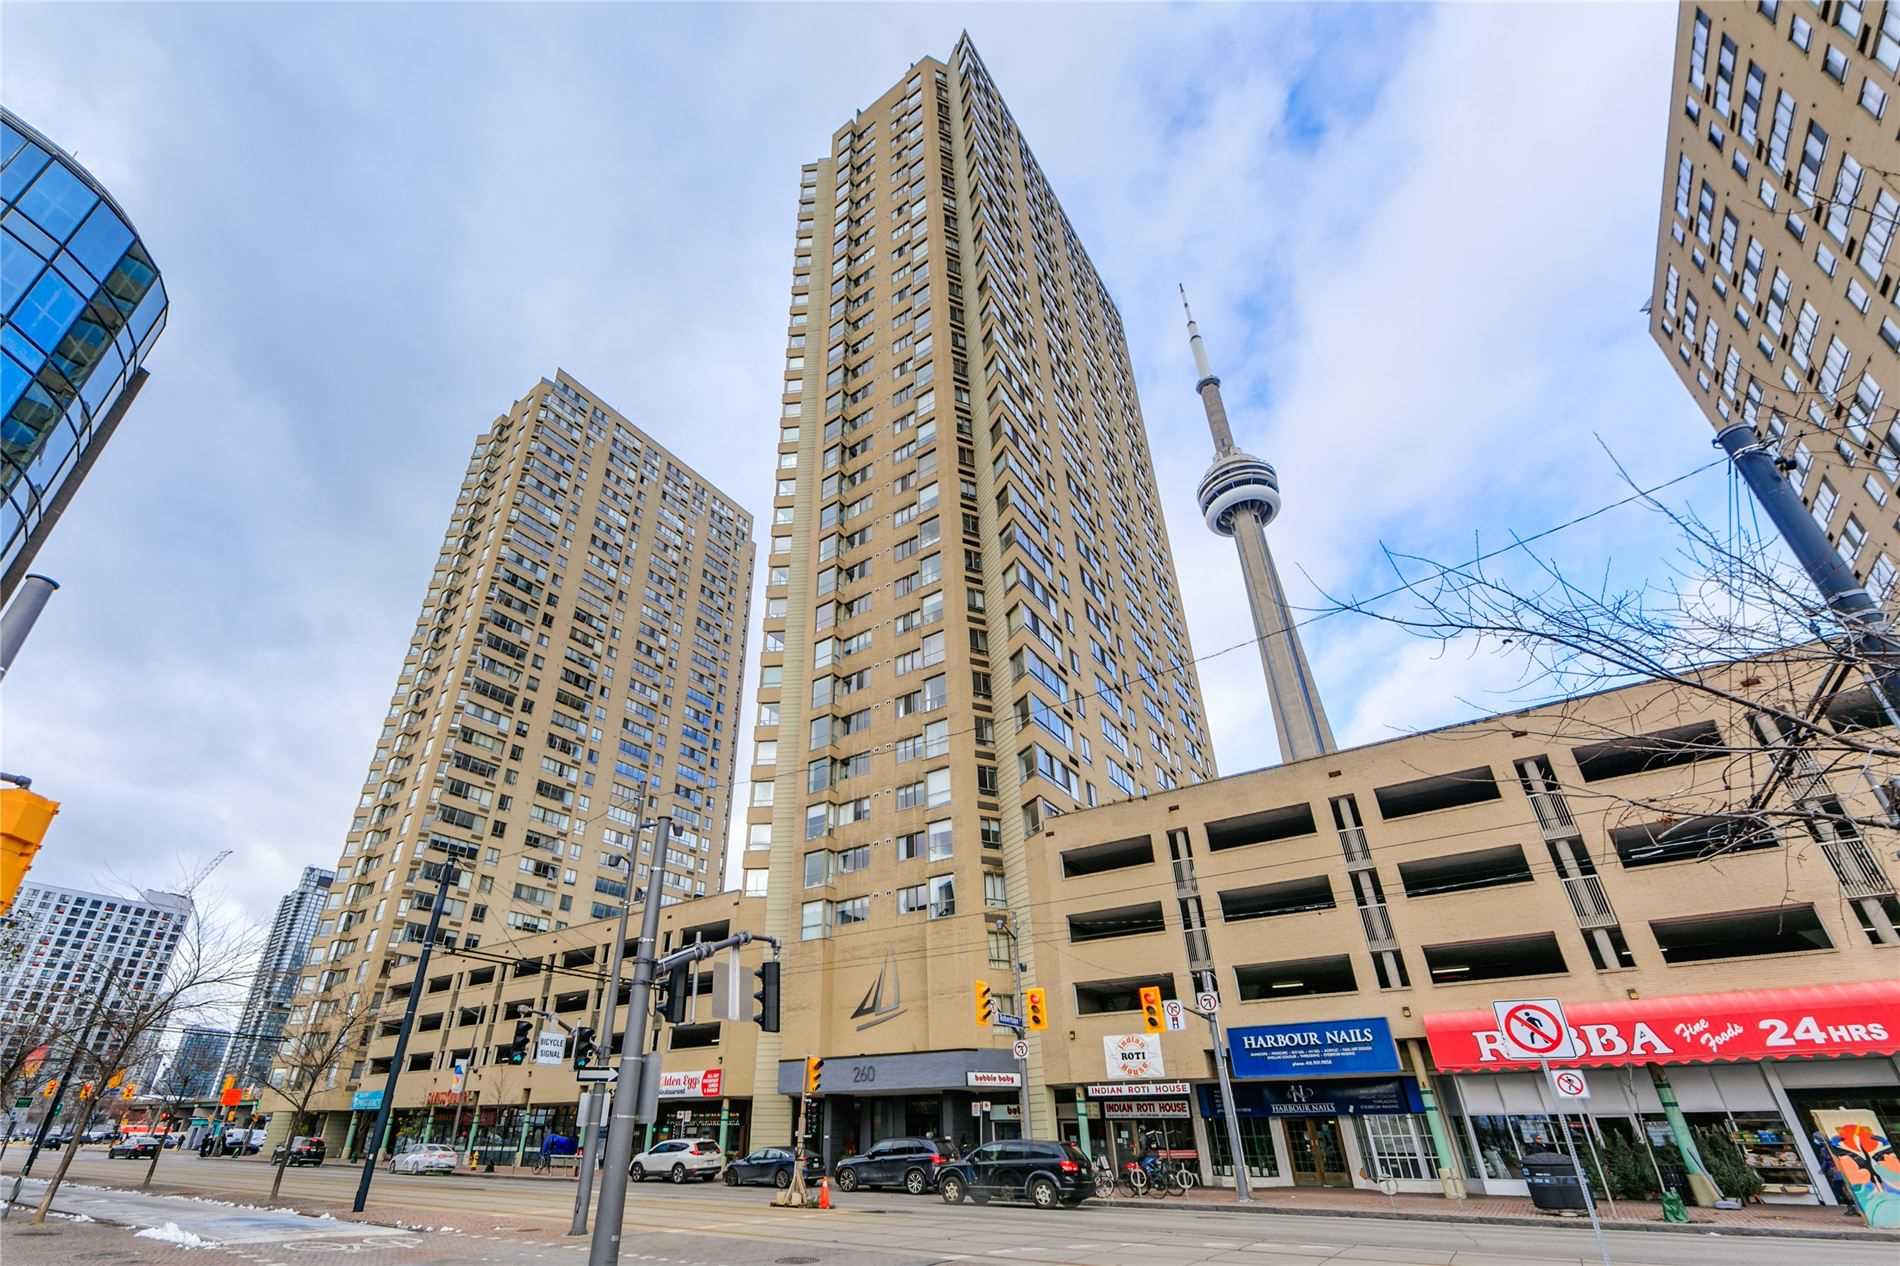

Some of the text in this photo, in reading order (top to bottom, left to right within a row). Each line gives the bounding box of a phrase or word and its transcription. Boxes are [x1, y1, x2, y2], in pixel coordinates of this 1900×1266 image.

[1674, 1019, 1709, 1042] Fine
[1758, 1016, 1889, 1047] 24 HRS
[540, 1038, 563, 1047] BICYCLE
[1243, 1028, 1373, 1049] HARBOUR NAILS
[1472, 1022, 1675, 1062] RBA
[1700, 1022, 1744, 1053] Foods
[540, 1050, 561, 1058] SIGNAL
[1121, 1051, 1146, 1061] ROTI
[852, 1066, 876, 1083] 260
[1128, 1086, 1150, 1094] ROTI
[1155, 1085, 1188, 1093] HOUSE
[1106, 1102, 1187, 1112] INDIAN ROTI HOUSE
[1271, 1103, 1336, 1113] HARBOUR NAILS
